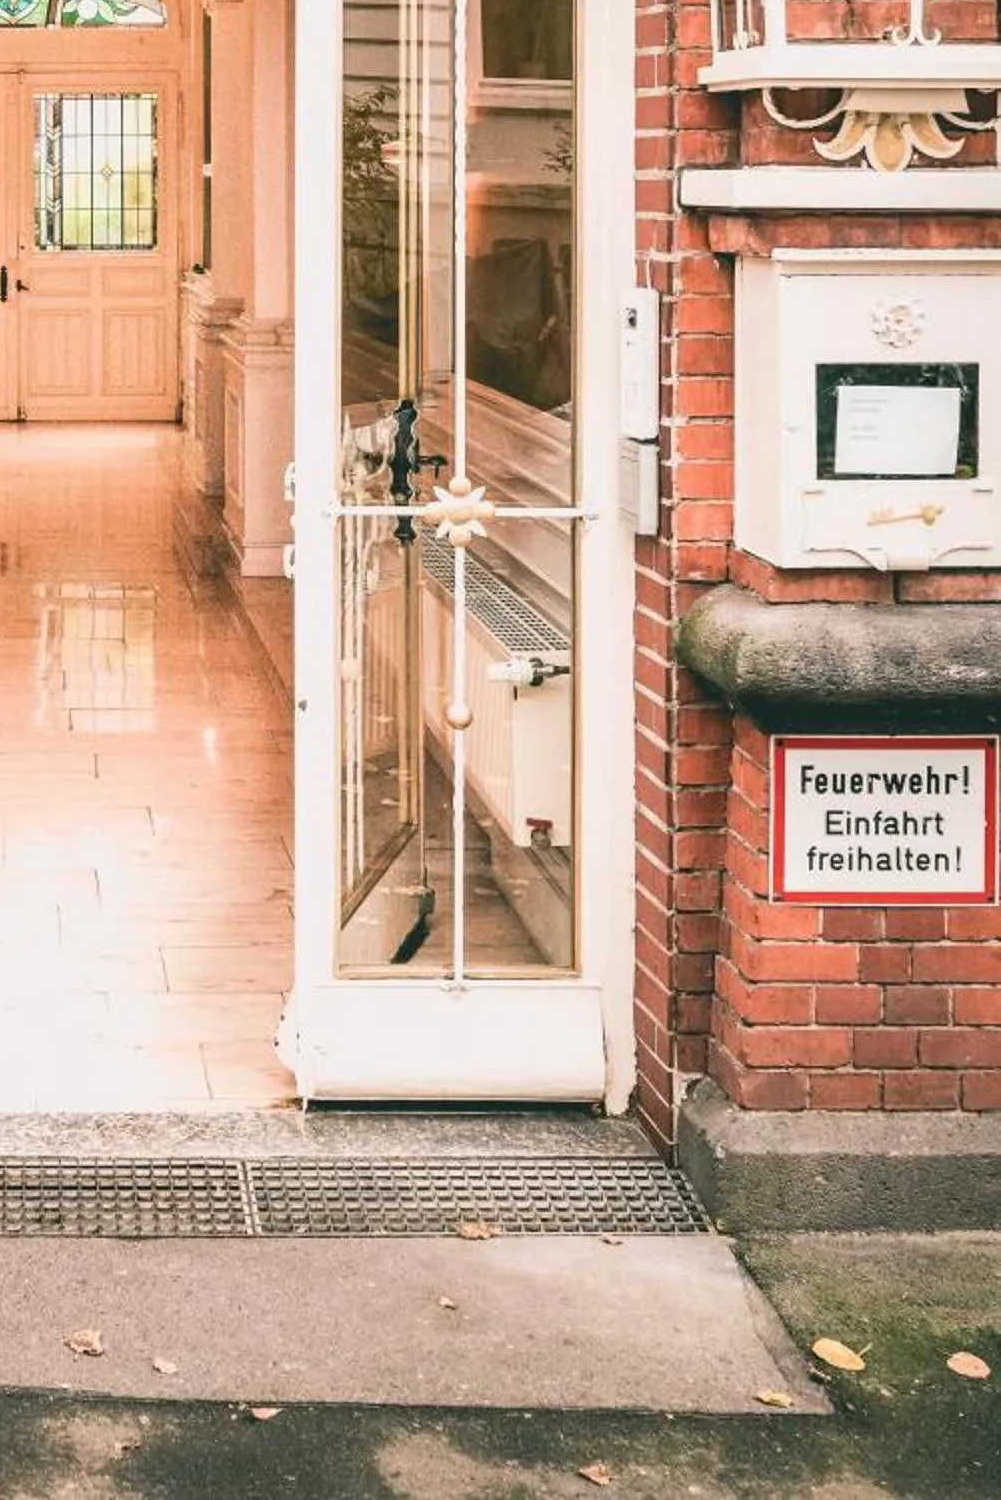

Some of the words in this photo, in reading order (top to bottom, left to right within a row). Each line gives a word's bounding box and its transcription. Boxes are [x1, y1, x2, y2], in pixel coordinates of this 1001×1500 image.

[800, 765, 970, 794] Feuerwehr!
[826, 810, 944, 836] Einfahrt
[807, 846, 962, 872] freihalten!
